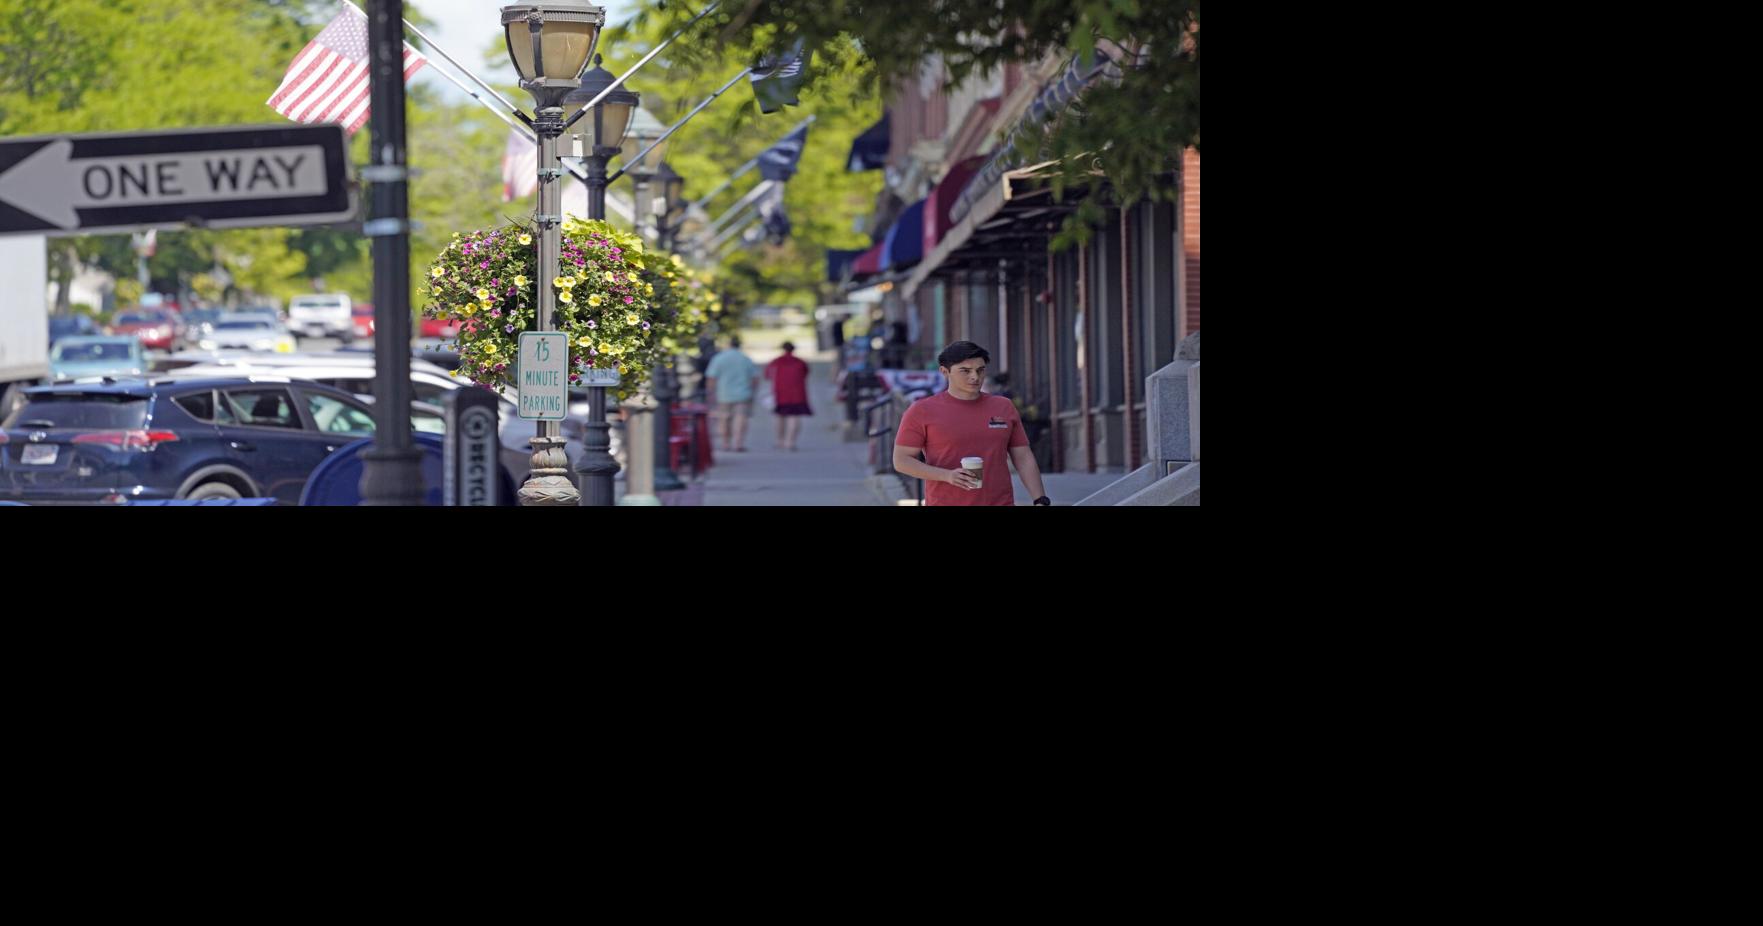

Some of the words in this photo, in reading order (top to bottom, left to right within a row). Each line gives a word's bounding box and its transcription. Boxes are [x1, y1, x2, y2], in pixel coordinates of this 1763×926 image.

[83, 161, 184, 200] ONE
[204, 154, 305, 192] WAY
[536, 341, 550, 362] 15
[525, 371, 559, 386] MINUTE
[523, 396, 560, 412] PARKING
